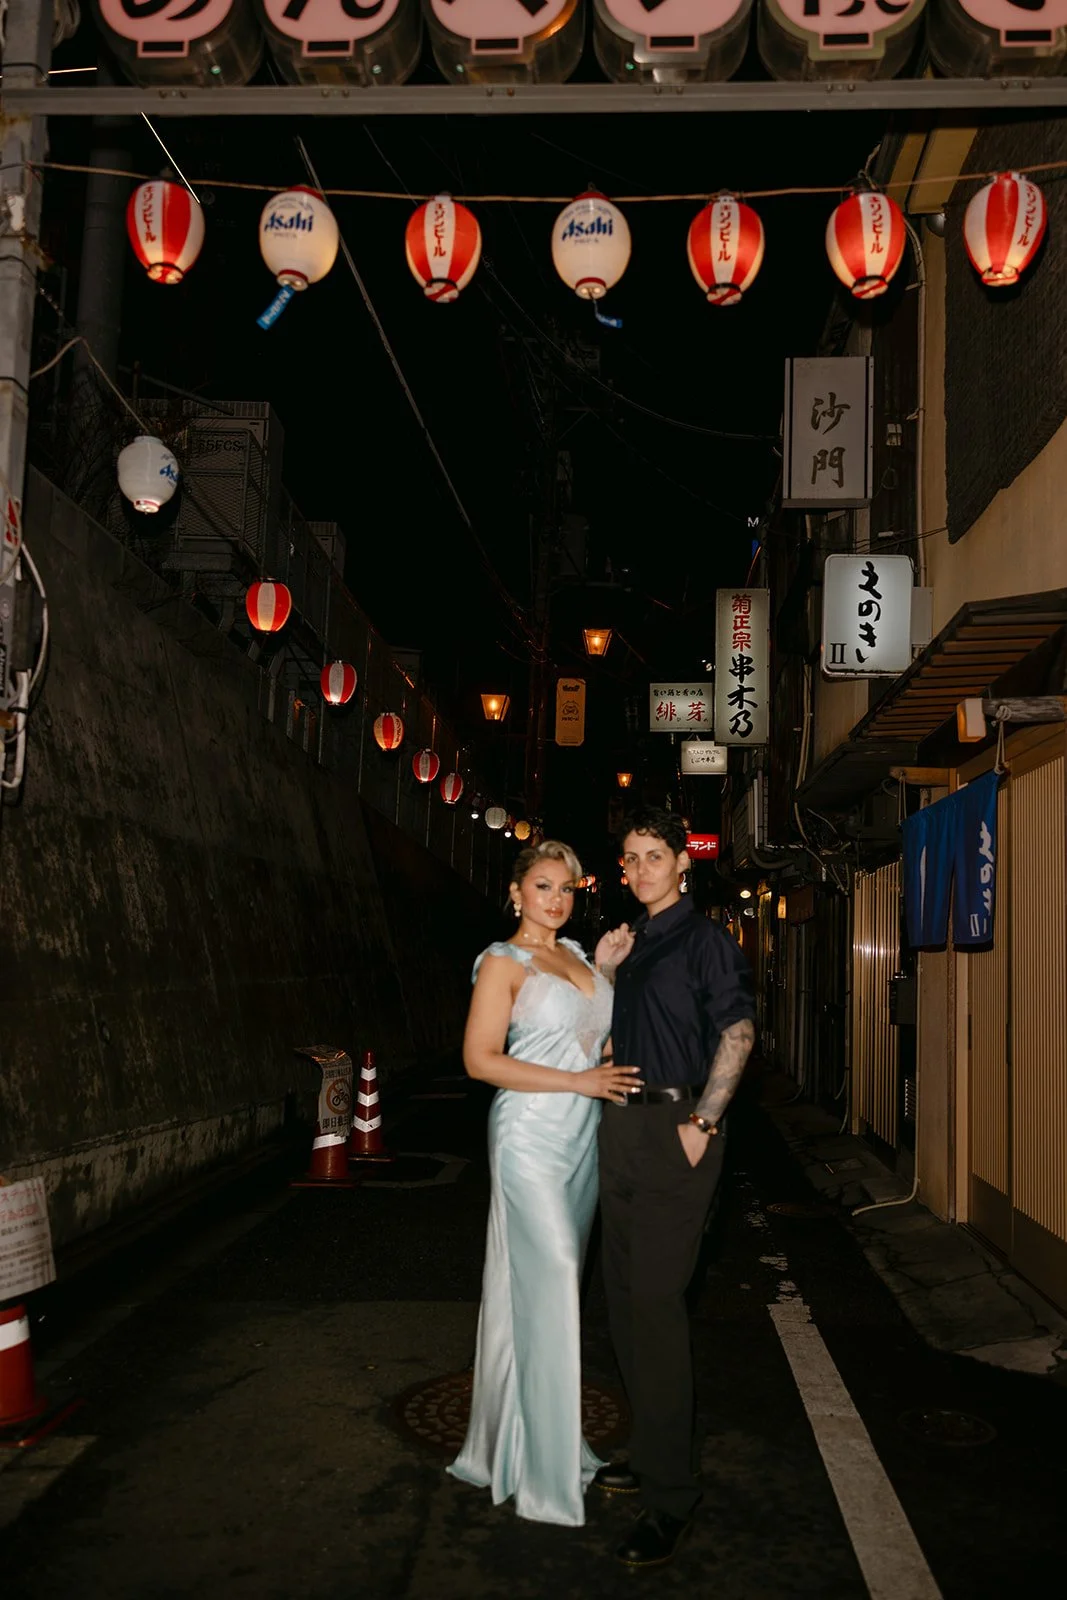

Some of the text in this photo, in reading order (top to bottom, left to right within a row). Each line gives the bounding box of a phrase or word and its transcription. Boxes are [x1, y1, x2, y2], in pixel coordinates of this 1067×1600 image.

[264, 211, 314, 233] Asahi
[561, 216, 613, 241] Asahi
[811, 391, 852, 489] 沙門
[731, 593, 752, 652] 菊正宗
[727, 652, 758, 739] 串木乃
